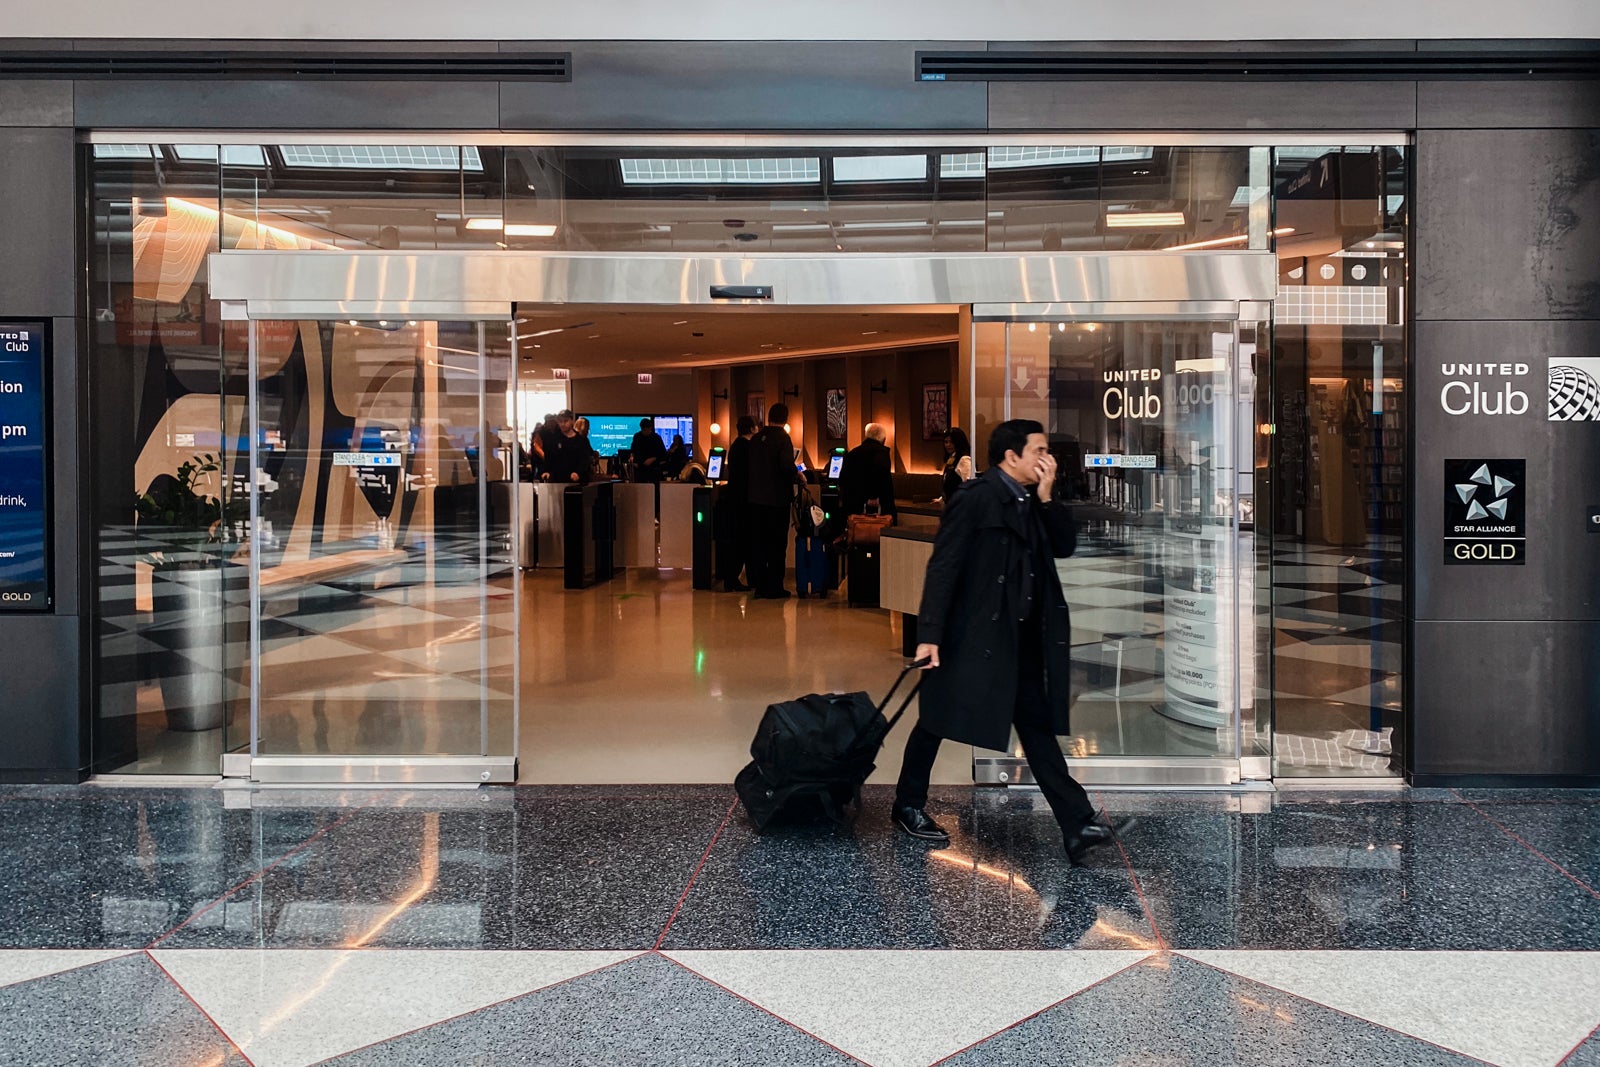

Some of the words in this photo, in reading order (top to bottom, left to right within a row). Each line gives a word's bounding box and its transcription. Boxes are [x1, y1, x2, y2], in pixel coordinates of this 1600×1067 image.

[5, 341, 29, 352] Club
[1103, 368, 1161, 383] UNITED
[1441, 363, 1530, 376] UNITED
[0, 381, 23, 393] ion
[1103, 386, 1161, 420] Club
[1440, 380, 1529, 415] Club
[2, 424, 27, 439] pm
[1453, 544, 1516, 559] GOLD
[2, 592, 31, 601] GOLD
